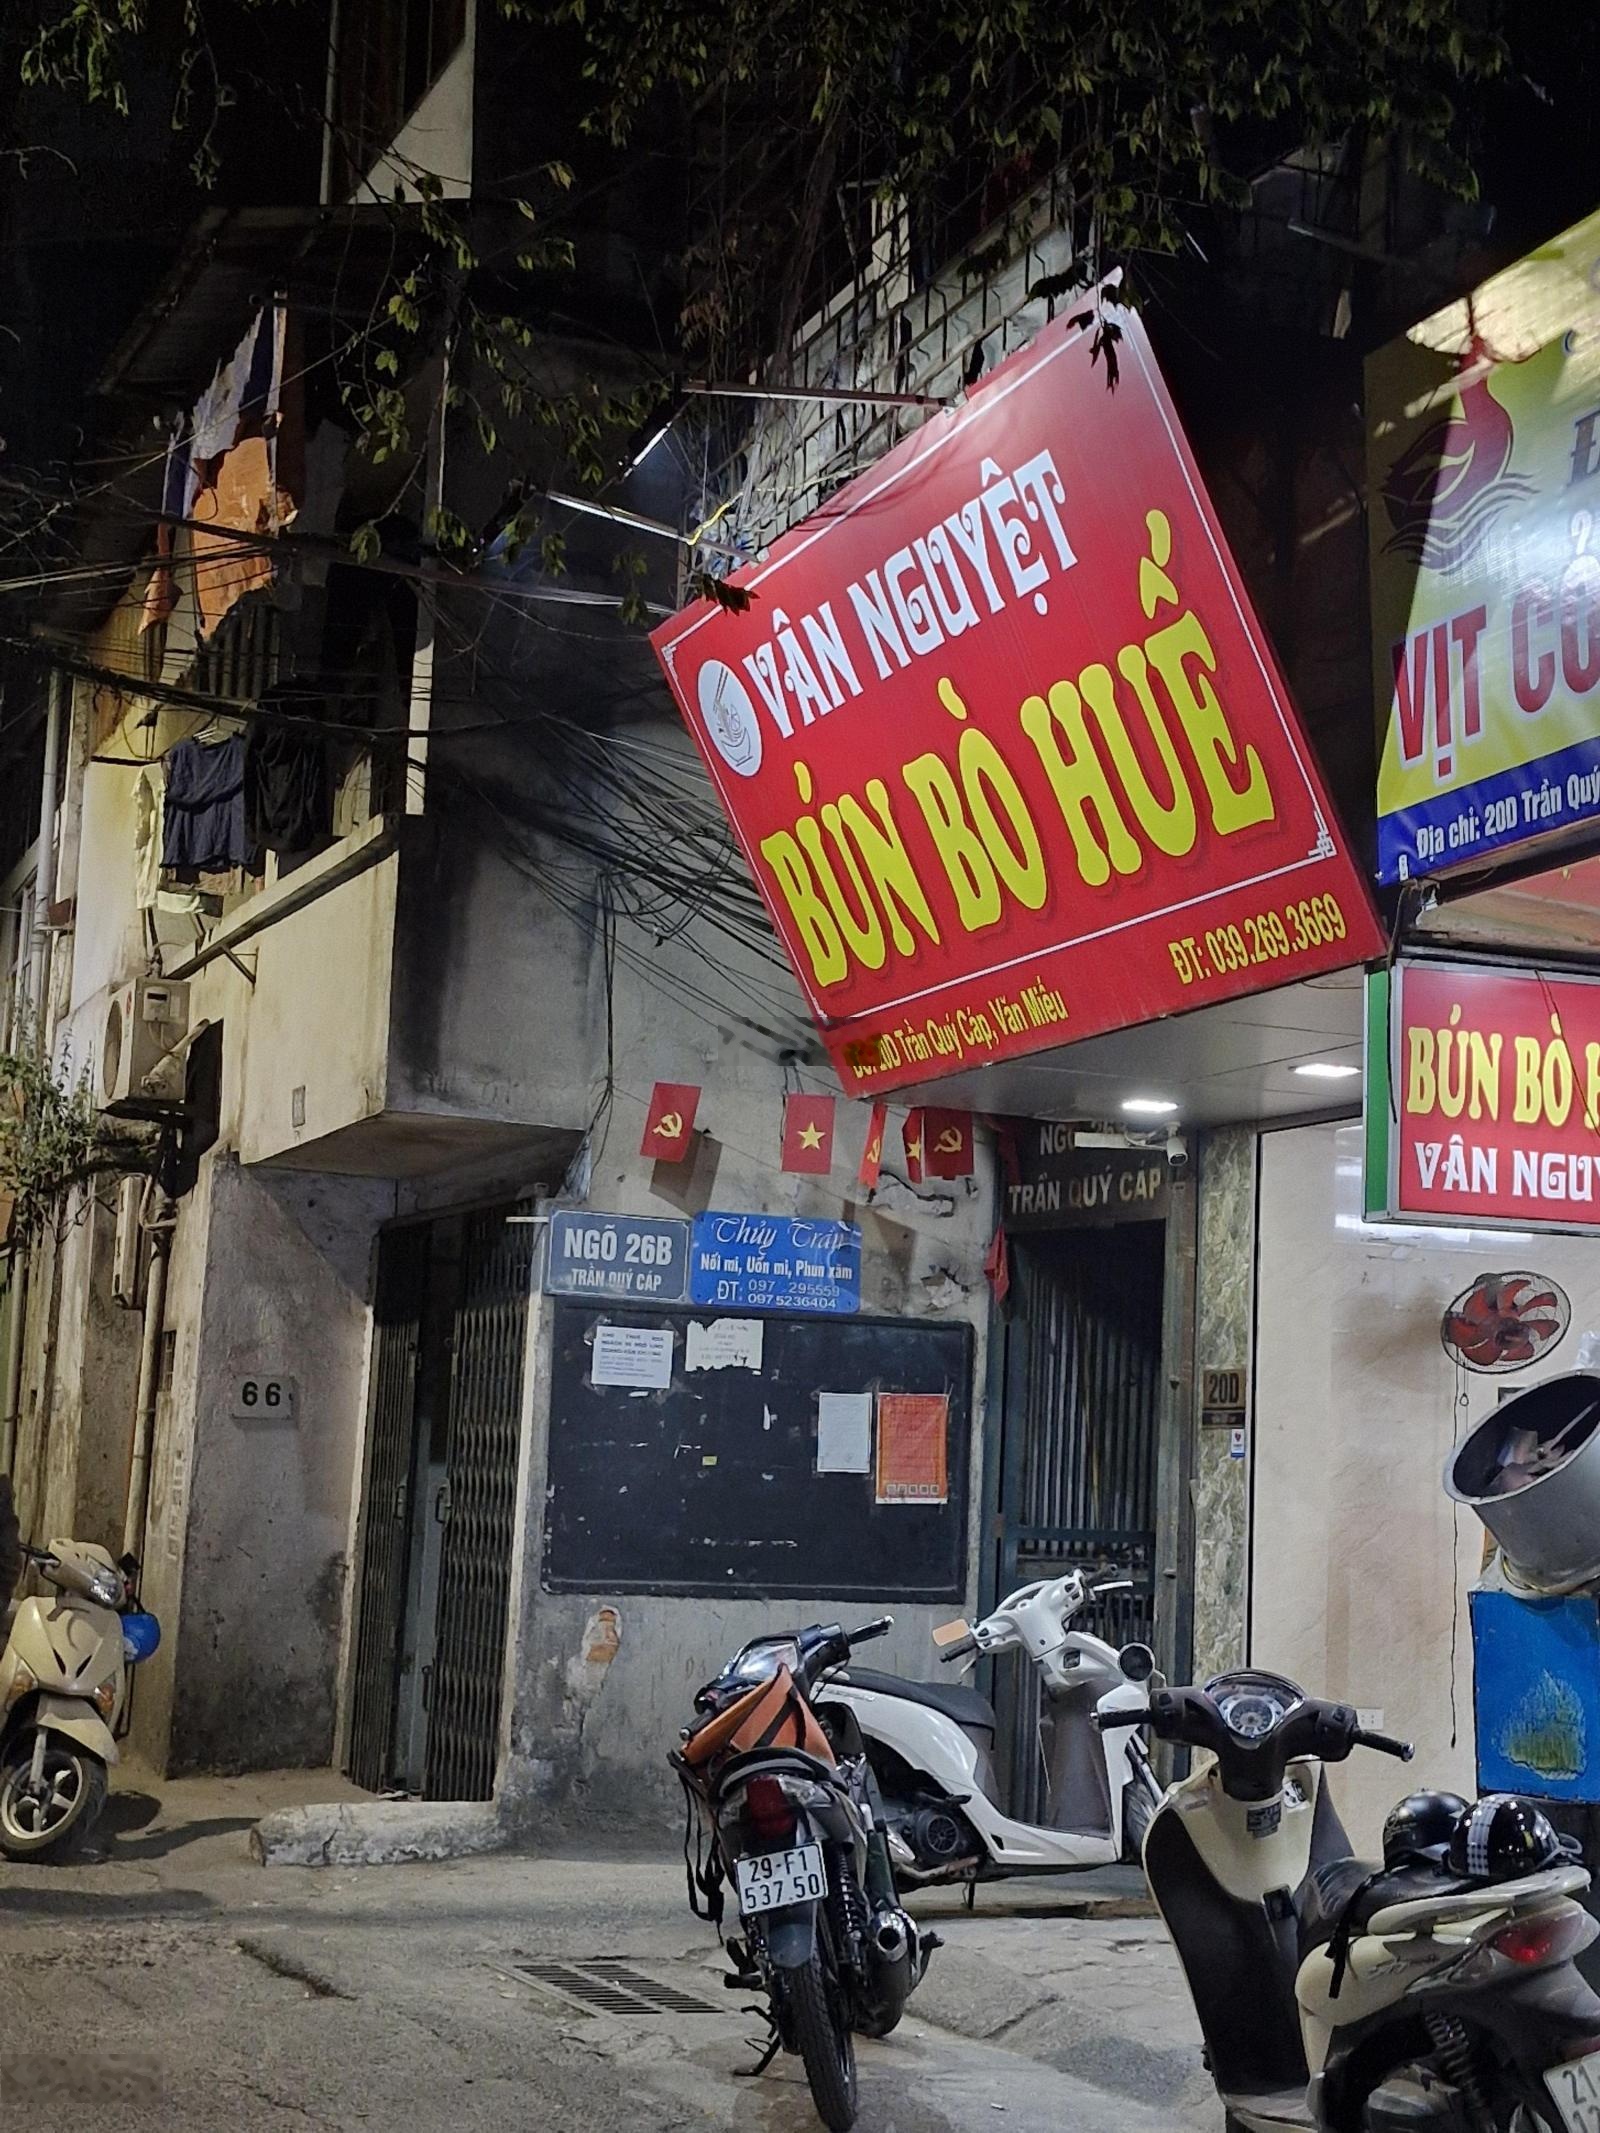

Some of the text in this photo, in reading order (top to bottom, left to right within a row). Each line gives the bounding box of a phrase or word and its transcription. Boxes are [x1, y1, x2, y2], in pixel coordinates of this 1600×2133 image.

[742, 448, 1078, 739] VÂN NGUYỆT
[1391, 604, 1488, 780] VỊT
[760, 509, 1276, 988] BÚN BÒ HUẾ
[1416, 824, 1445, 862] Địa
[1449, 806, 1481, 848] chỉ:
[1484, 796, 1518, 837] 20D
[1521, 778, 1562, 823] Trần
[1168, 893, 1346, 984] ĐT: 039.269.3669
[895, 1018, 934, 1063] Trần
[926, 1012, 963, 1060] Quý
[956, 1006, 999, 1050] Cáp,
[988, 995, 1029, 1036] Văn
[1019, 975, 1069, 1027] Miếu
[1406, 1003, 1503, 1122] BÚN
[1513, 1012, 1573, 1127] BÒ
[1069, 1164, 1113, 1208] QUÝ
[1120, 1160, 1161, 1201] CÁP
[1414, 1134, 1600, 1202] VÂN NGU
[564, 1224, 673, 1266] NGÕ 26B
[700, 1252, 721, 1272] Nối
[724, 1255, 742, 1276] mi,
[746, 1255, 770, 1276] Uốn
[774, 1258, 792, 1279] mi,
[796, 1260, 825, 1279] Phun
[571, 1262, 605, 1288] TRẦN
[636, 1270, 662, 1292] CÁP
[717, 1280, 743, 1301] ĐT:
[242, 1381, 281, 1407] 66
[1208, 1373, 1240, 1404] 20D
[748, 1850, 808, 1883] 29-F1
[744, 1874, 820, 1909] 537.50
